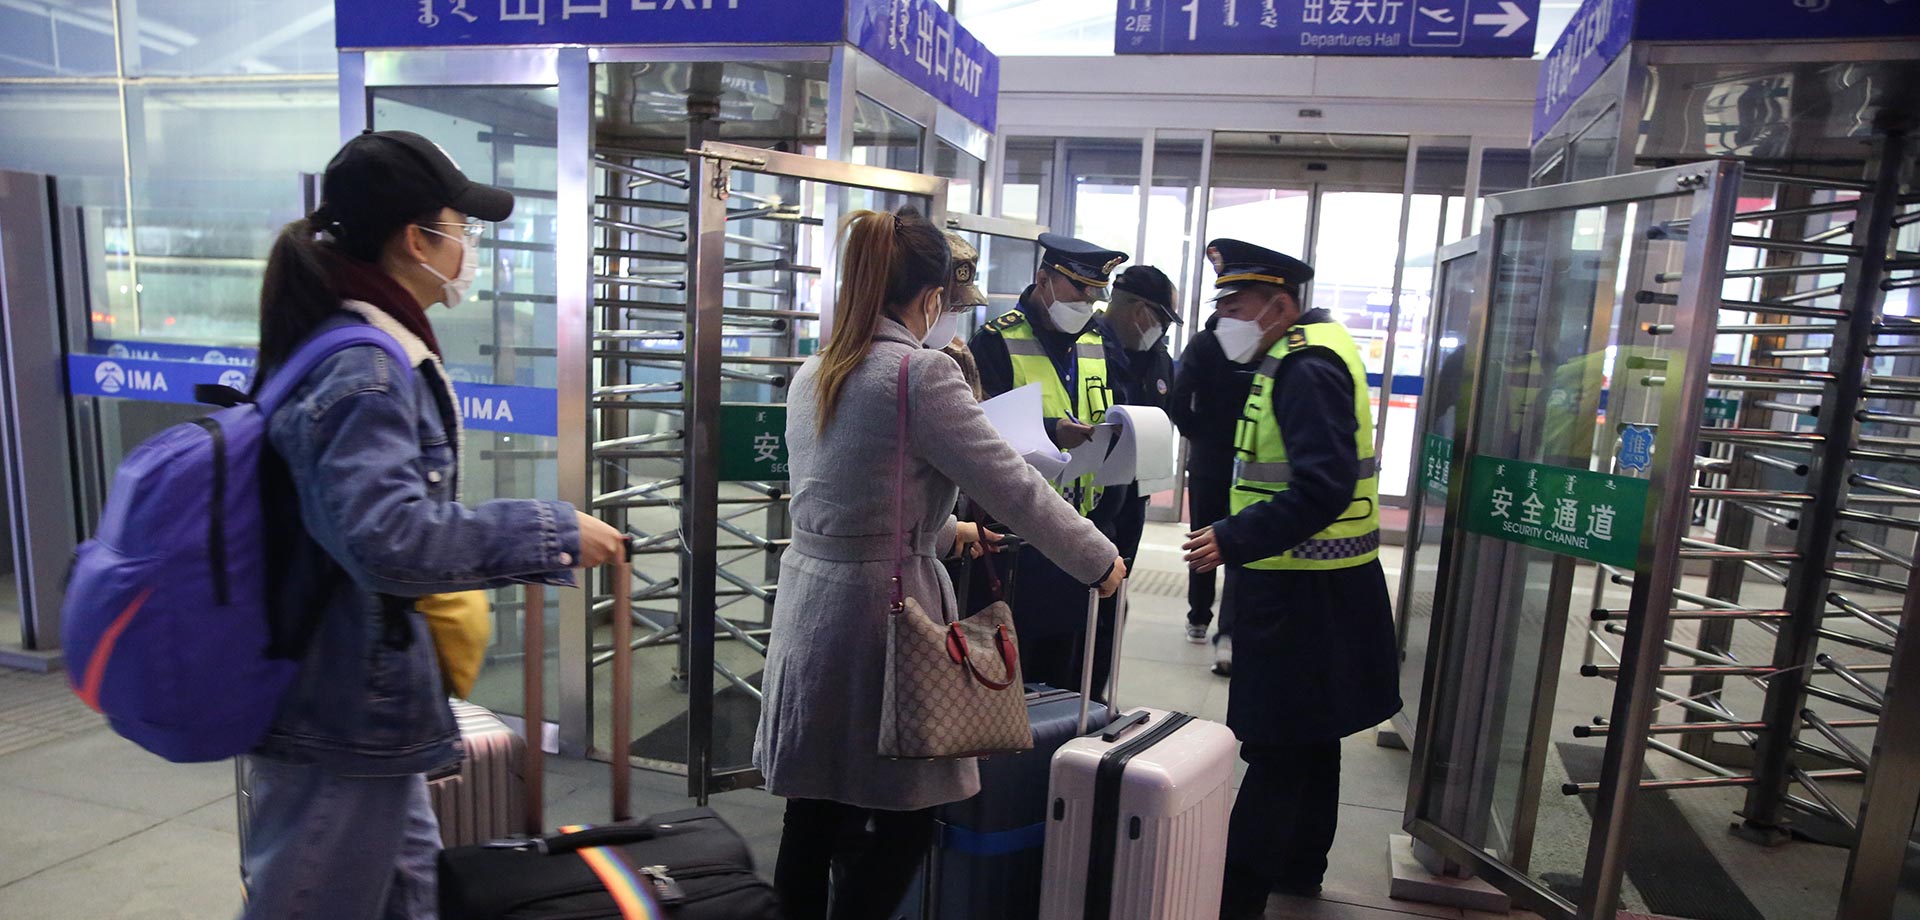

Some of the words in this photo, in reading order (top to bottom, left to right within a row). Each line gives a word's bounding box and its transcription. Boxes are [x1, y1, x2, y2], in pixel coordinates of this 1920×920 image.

[1125, 14, 1153, 32] 2层
[1302, 0, 1403, 25] 出发大厅
[915, 9, 951, 82] 出口
[1300, 32, 1372, 48] Departures
[1375, 32, 1401, 46] Hall
[953, 47, 983, 98] EXIT
[127, 369, 169, 392] IMA
[463, 396, 514, 422] IMA
[753, 431, 780, 463] 安
[1490, 486, 1617, 541] 安全通道
[1502, 521, 1543, 539] SECURITY
[1544, 529, 1590, 550] CHANNEL
